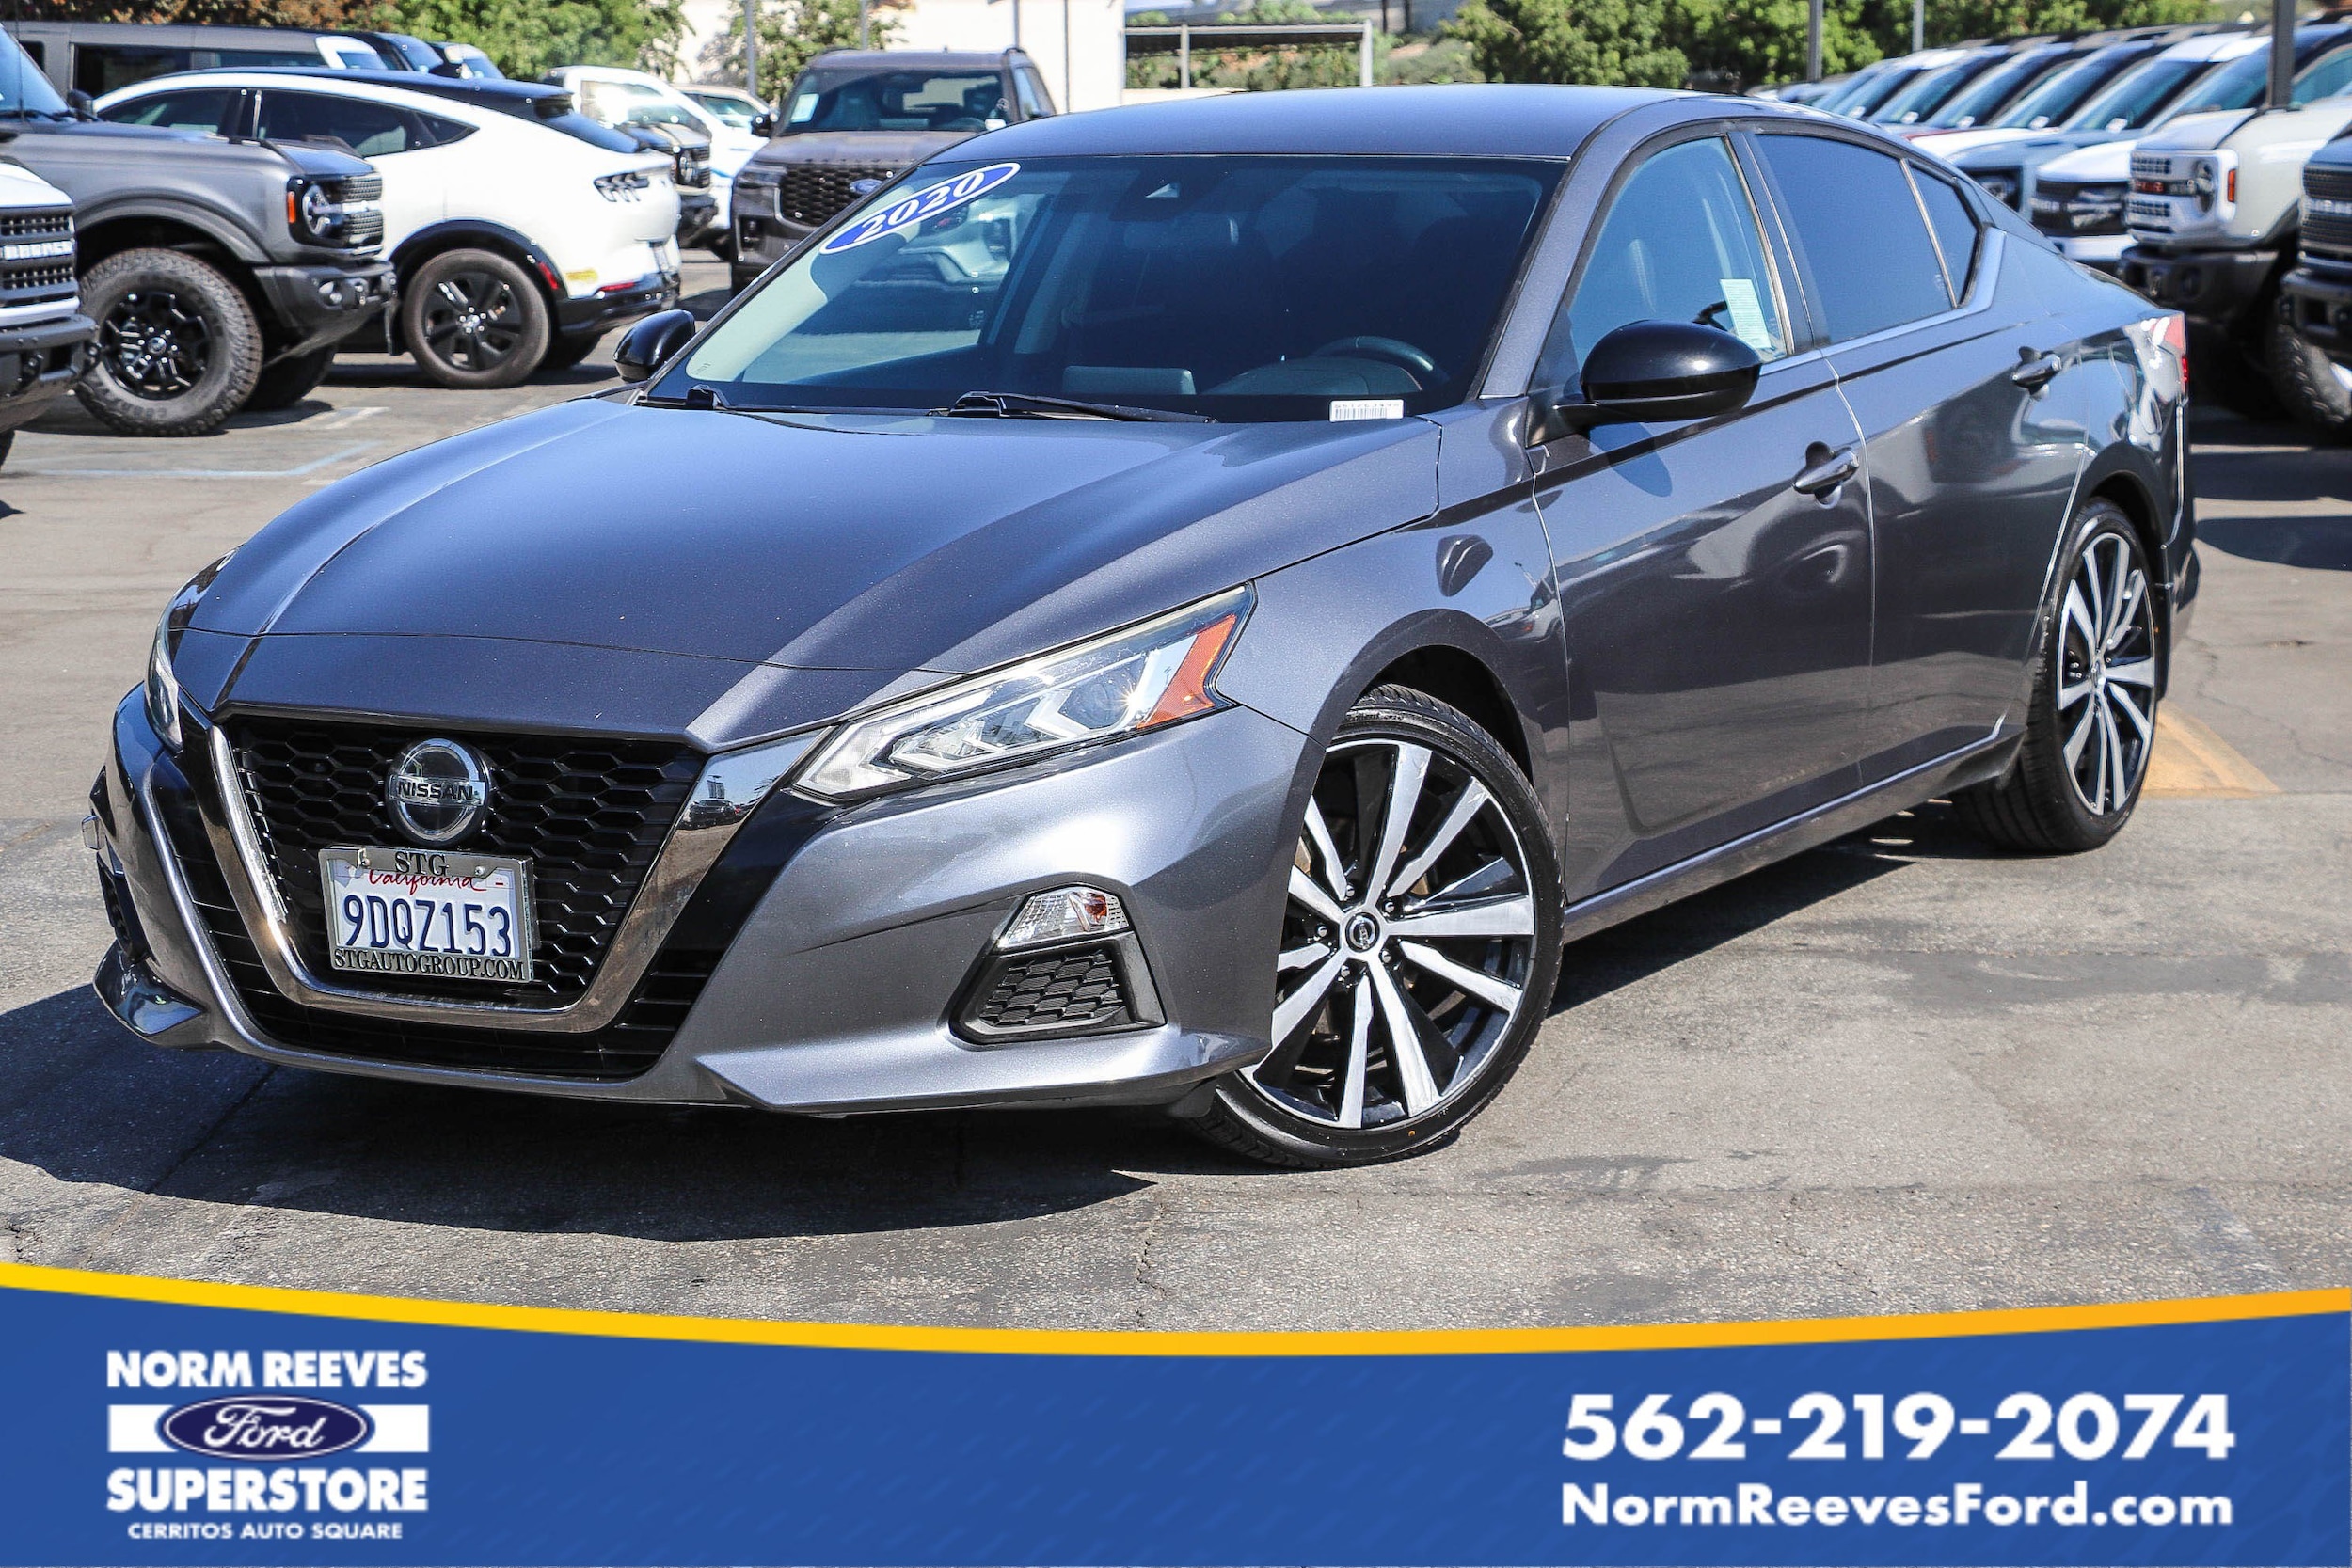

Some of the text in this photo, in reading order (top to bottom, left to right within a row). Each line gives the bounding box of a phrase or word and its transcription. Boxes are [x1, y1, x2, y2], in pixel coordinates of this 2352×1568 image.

[853, 172, 985, 243] 2020
[398, 781, 474, 800] NISSAN
[395, 850, 448, 877] STG
[342, 895, 511, 957] 9DQZ153
[334, 948, 525, 981] STGAUTOGROUP.COM
